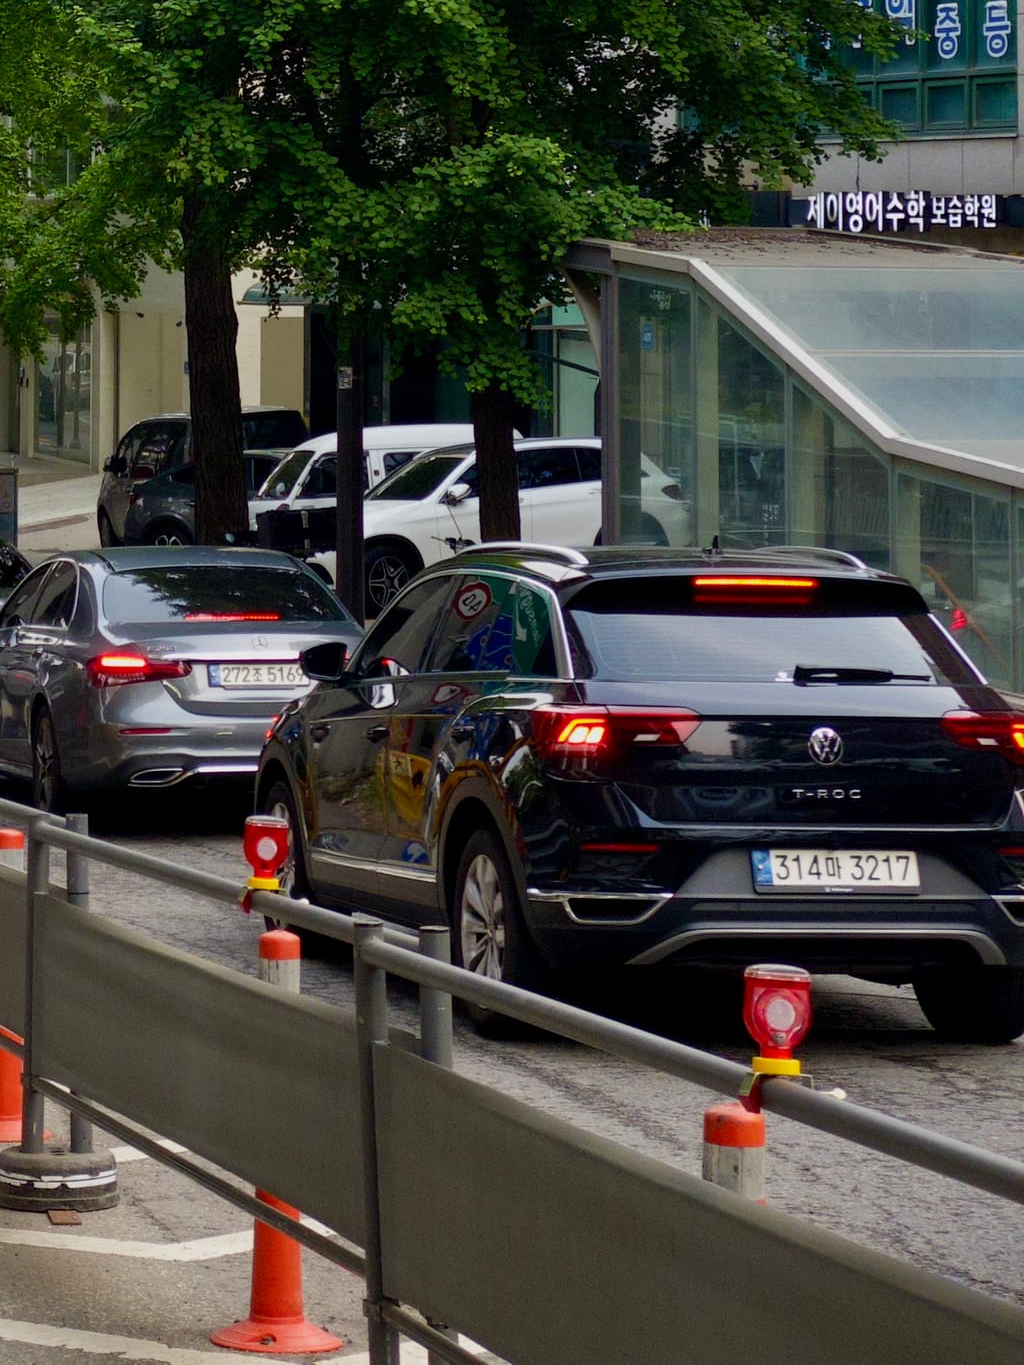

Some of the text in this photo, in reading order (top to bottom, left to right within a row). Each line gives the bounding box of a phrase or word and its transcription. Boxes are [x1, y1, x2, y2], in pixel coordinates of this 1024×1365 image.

[806, 190, 997, 234] 제이영어수학 보습학원
[222, 667, 305, 683] 272조 5169
[791, 789, 863, 799] T-ROC
[774, 854, 911, 881] 314마 3217
